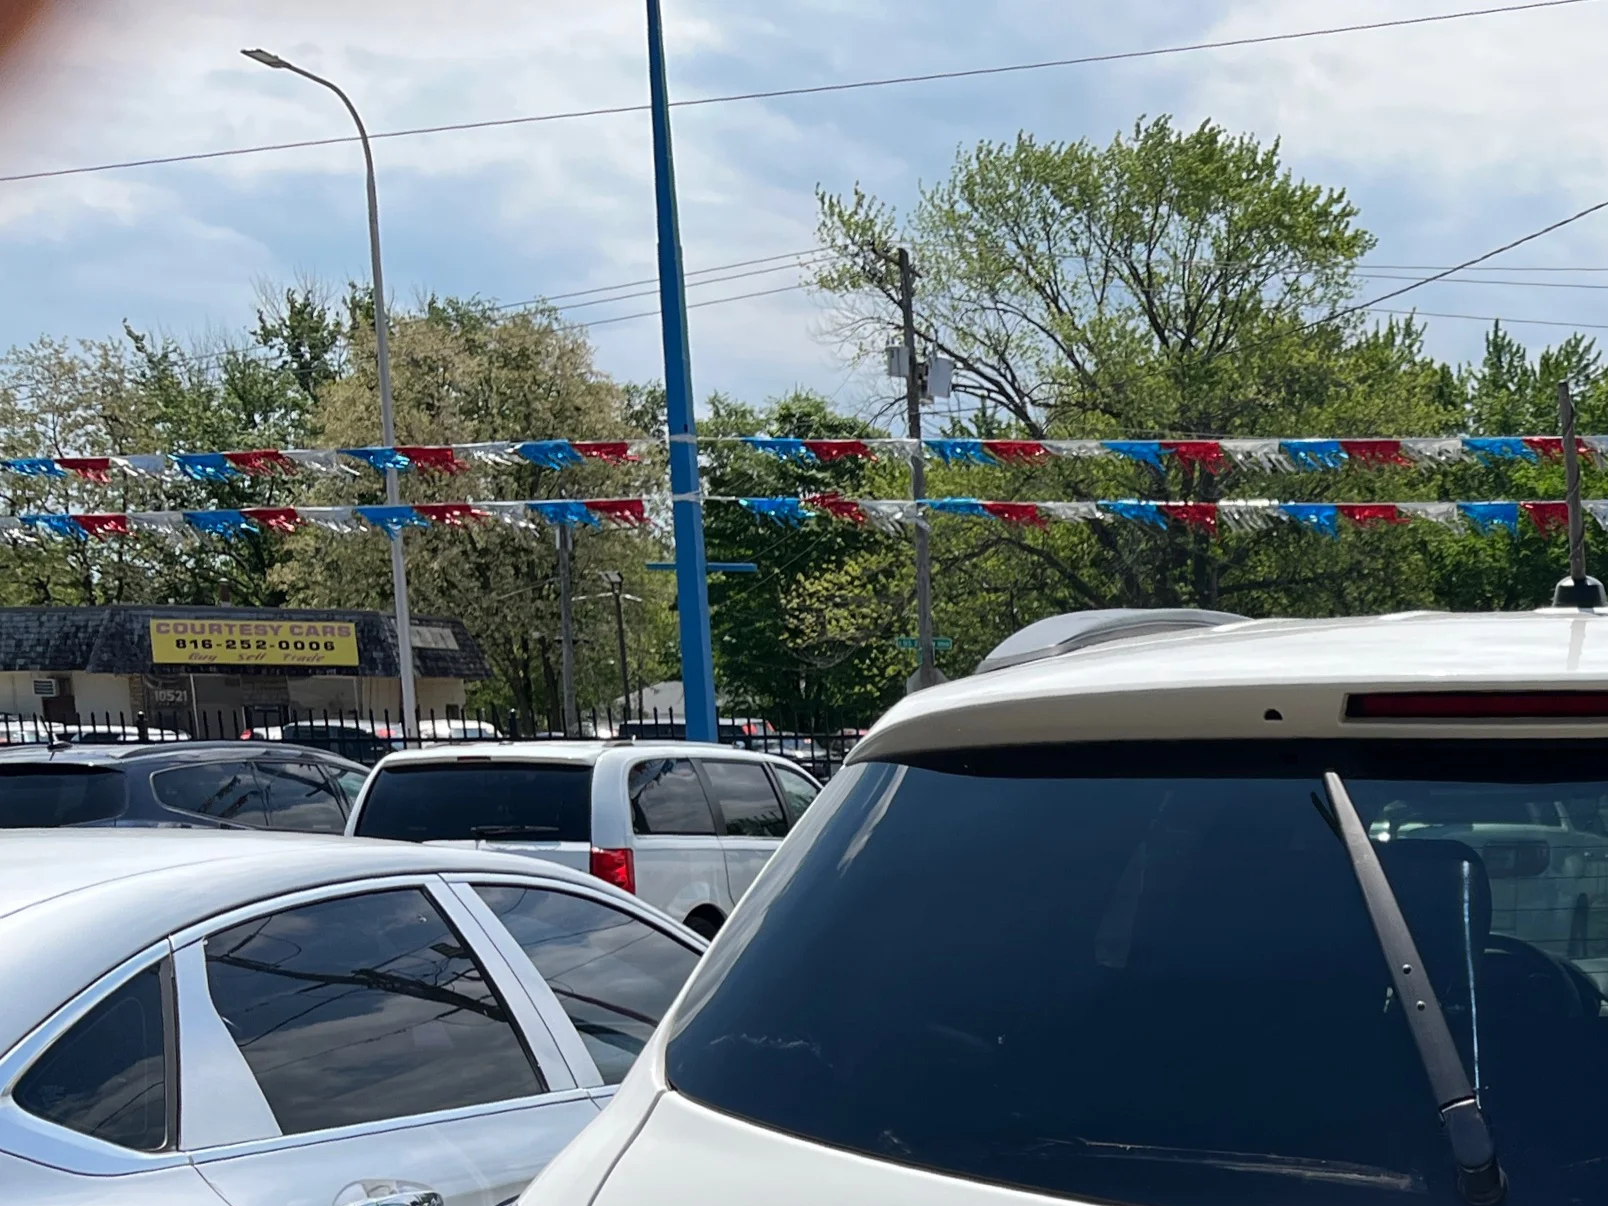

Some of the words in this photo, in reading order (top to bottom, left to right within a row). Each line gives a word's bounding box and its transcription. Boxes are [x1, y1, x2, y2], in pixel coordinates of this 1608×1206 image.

[156, 622, 284, 636] COURTESY
[289, 624, 351, 637] CARS
[175, 638, 336, 651] 816-252-0006
[188, 652, 218, 662] Buy
[237, 652, 268, 661] Sell
[283, 652, 325, 662] Trade
[154, 690, 188, 702] 10521
